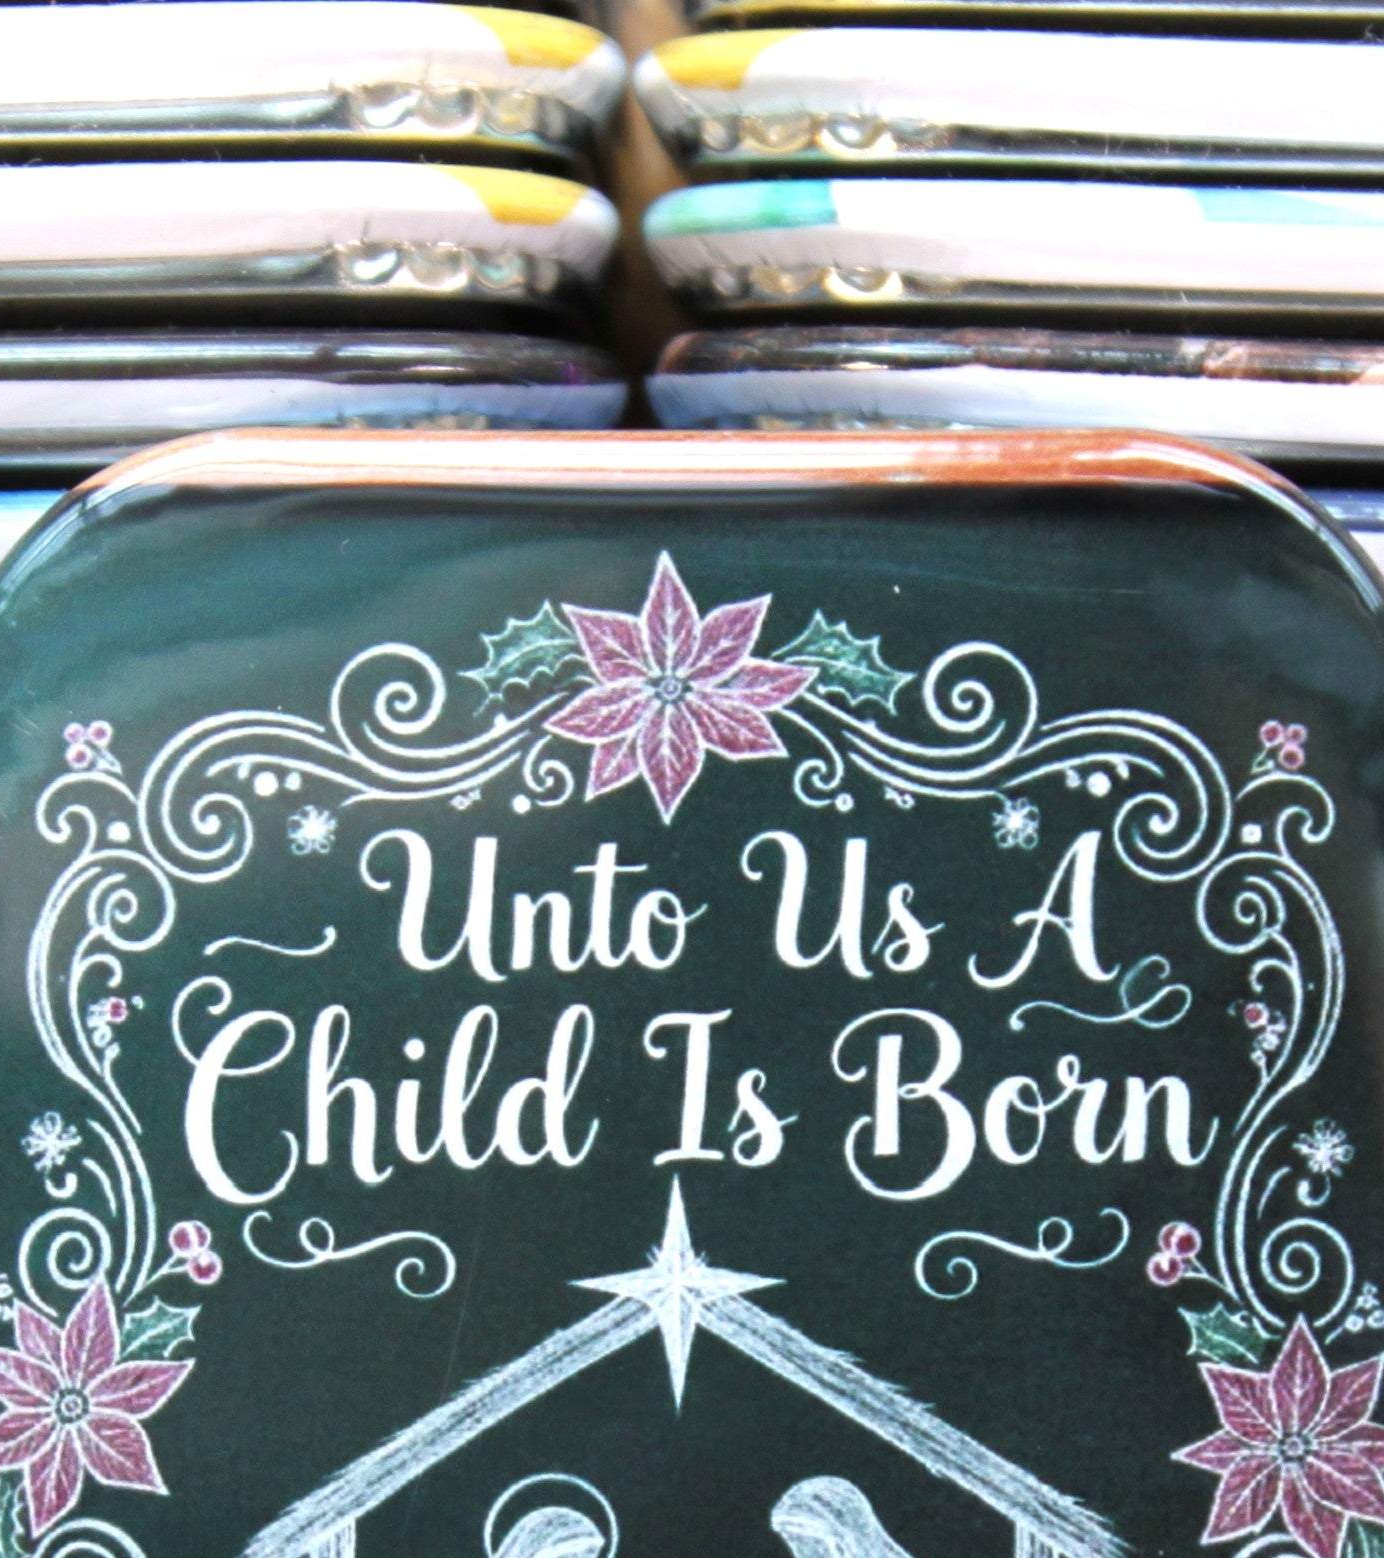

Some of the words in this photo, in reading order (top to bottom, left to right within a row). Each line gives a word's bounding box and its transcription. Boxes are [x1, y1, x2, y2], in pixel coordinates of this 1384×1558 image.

[359, 829, 707, 982] Unto
[741, 830, 945, 979] Us
[967, 829, 1122, 988] A
[172, 976, 600, 1204] Child
[644, 1008, 799, 1167] Is
[832, 1007, 1219, 1201] Born
